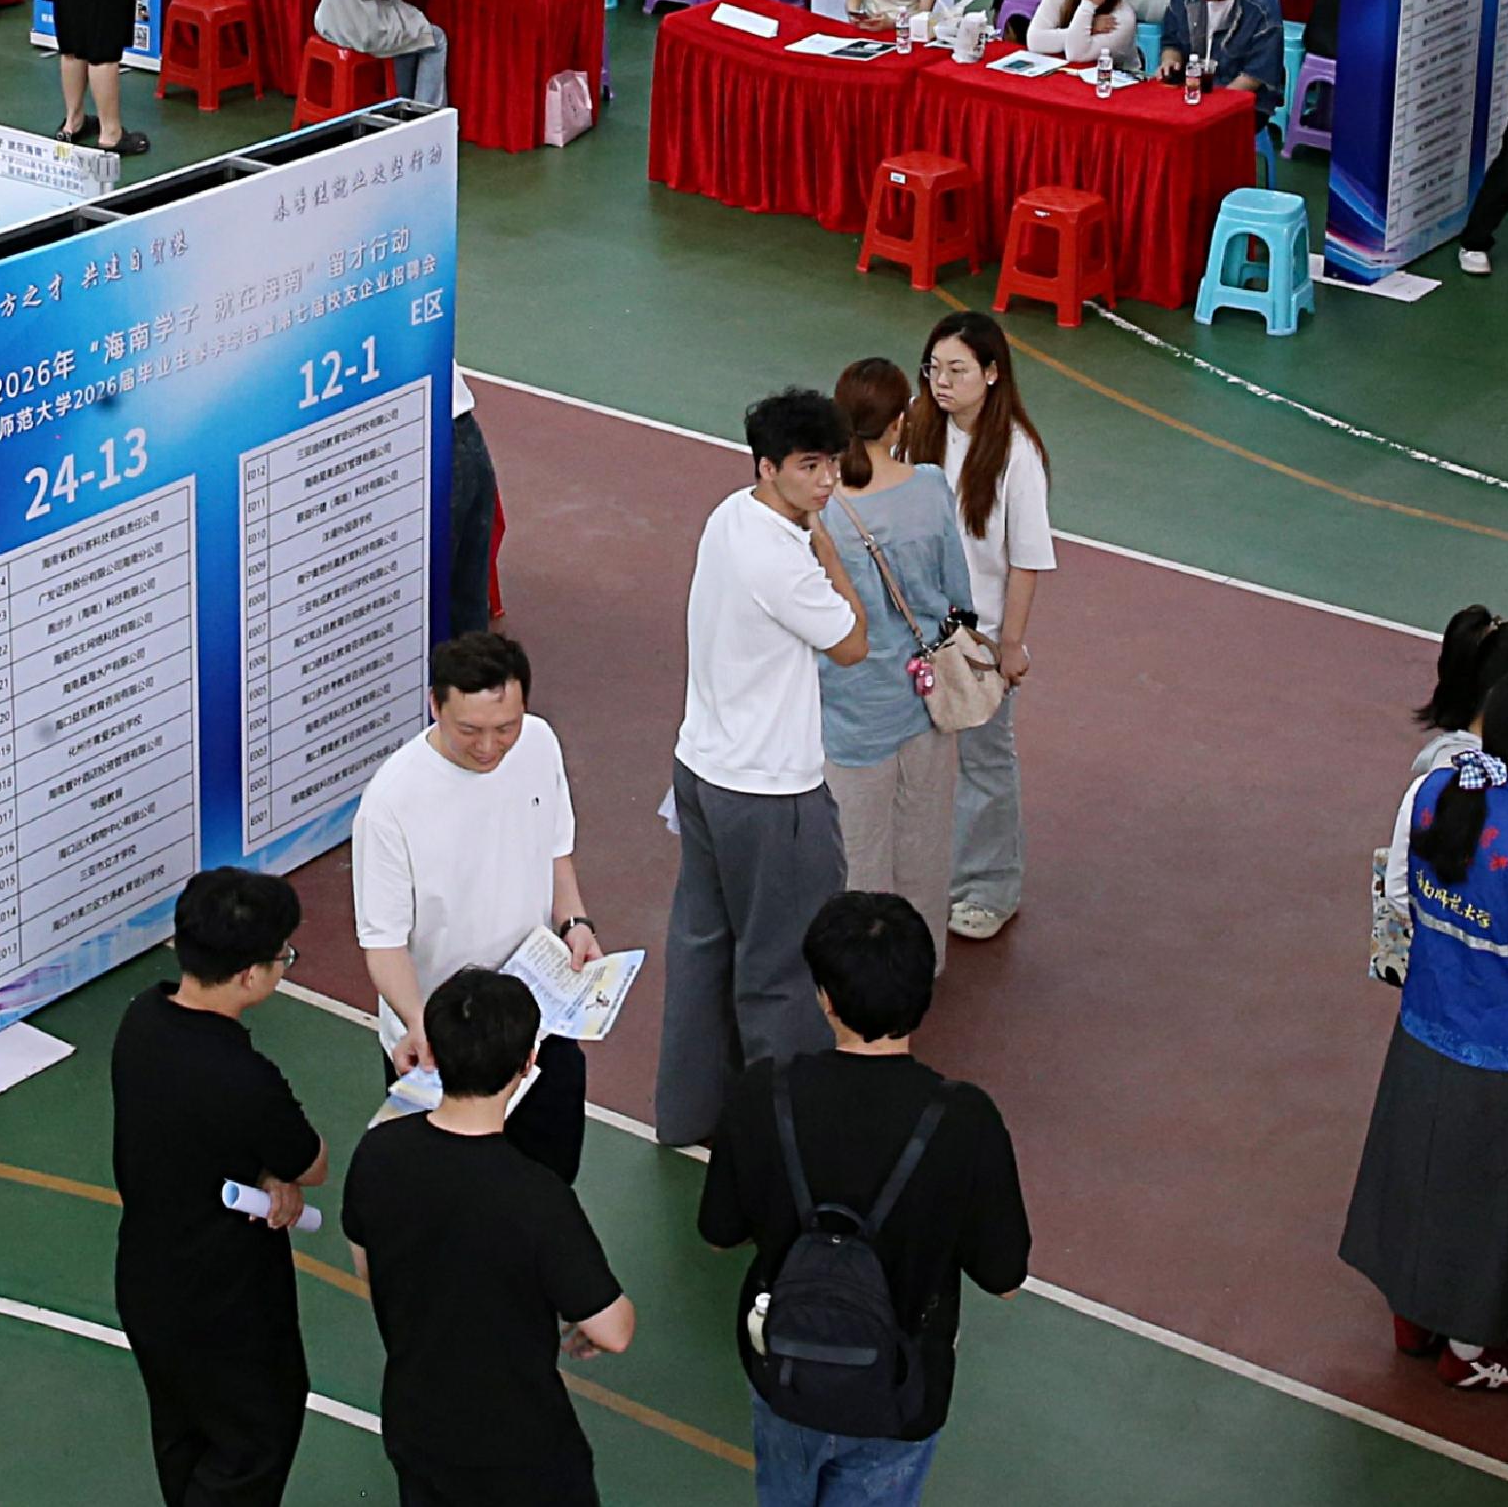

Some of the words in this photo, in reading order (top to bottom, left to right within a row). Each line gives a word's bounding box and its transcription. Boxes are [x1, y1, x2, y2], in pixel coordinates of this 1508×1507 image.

[89, 302, 199, 362] “海南学子
[327, 224, 411, 279] 留才行动
[409, 288, 444, 327] E区
[298, 335, 380, 410] 12-1
[24, 426, 149, 522] 24-13
